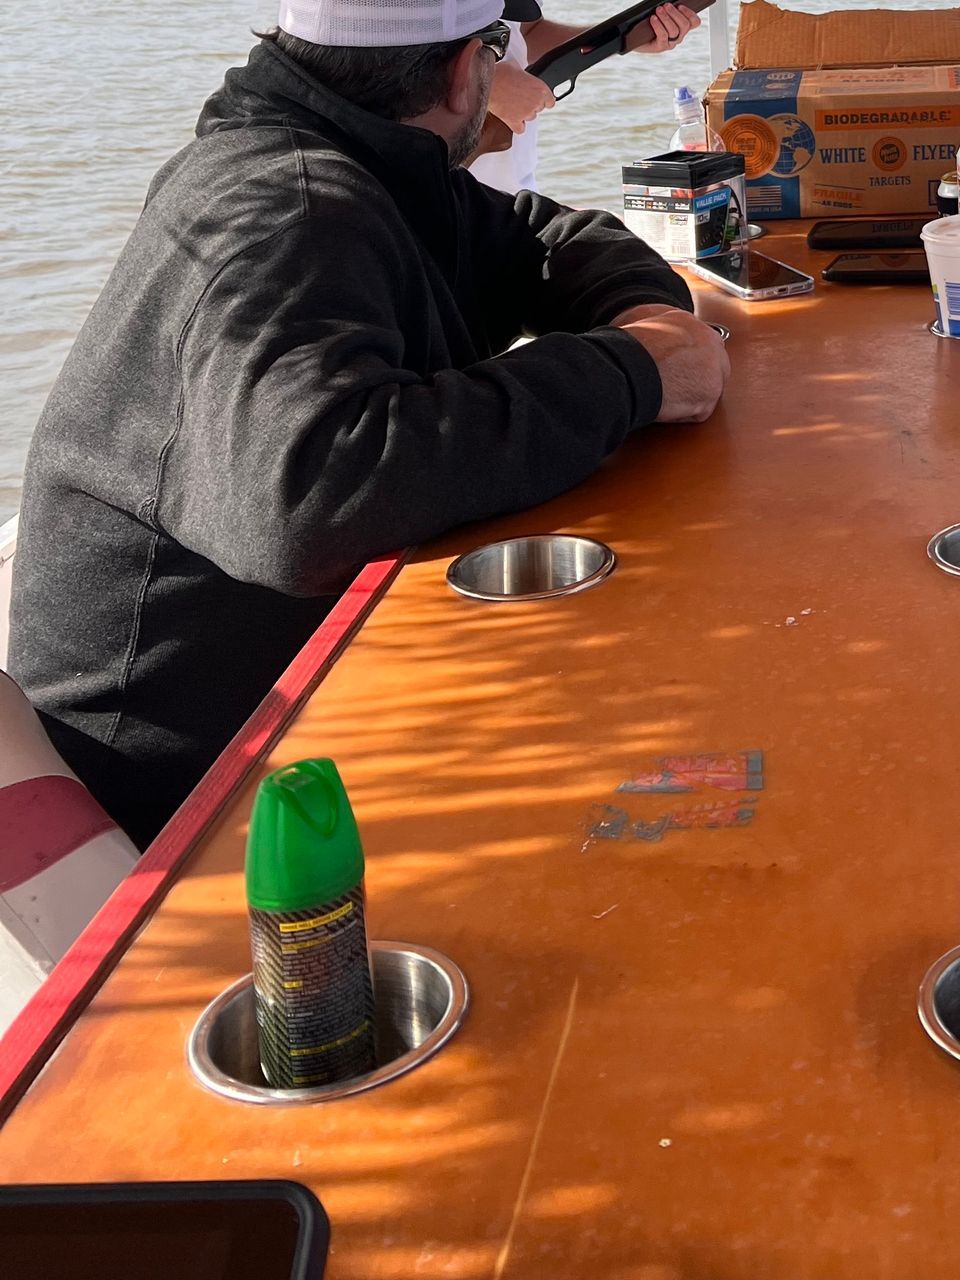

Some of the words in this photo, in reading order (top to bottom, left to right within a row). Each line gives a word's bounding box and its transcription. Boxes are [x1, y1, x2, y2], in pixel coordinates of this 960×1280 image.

[819, 147, 866, 164] WHITE
[913, 144, 958, 162] FLYER
[869, 176, 911, 187] TARGETS
[713, 192, 727, 203] PACK
